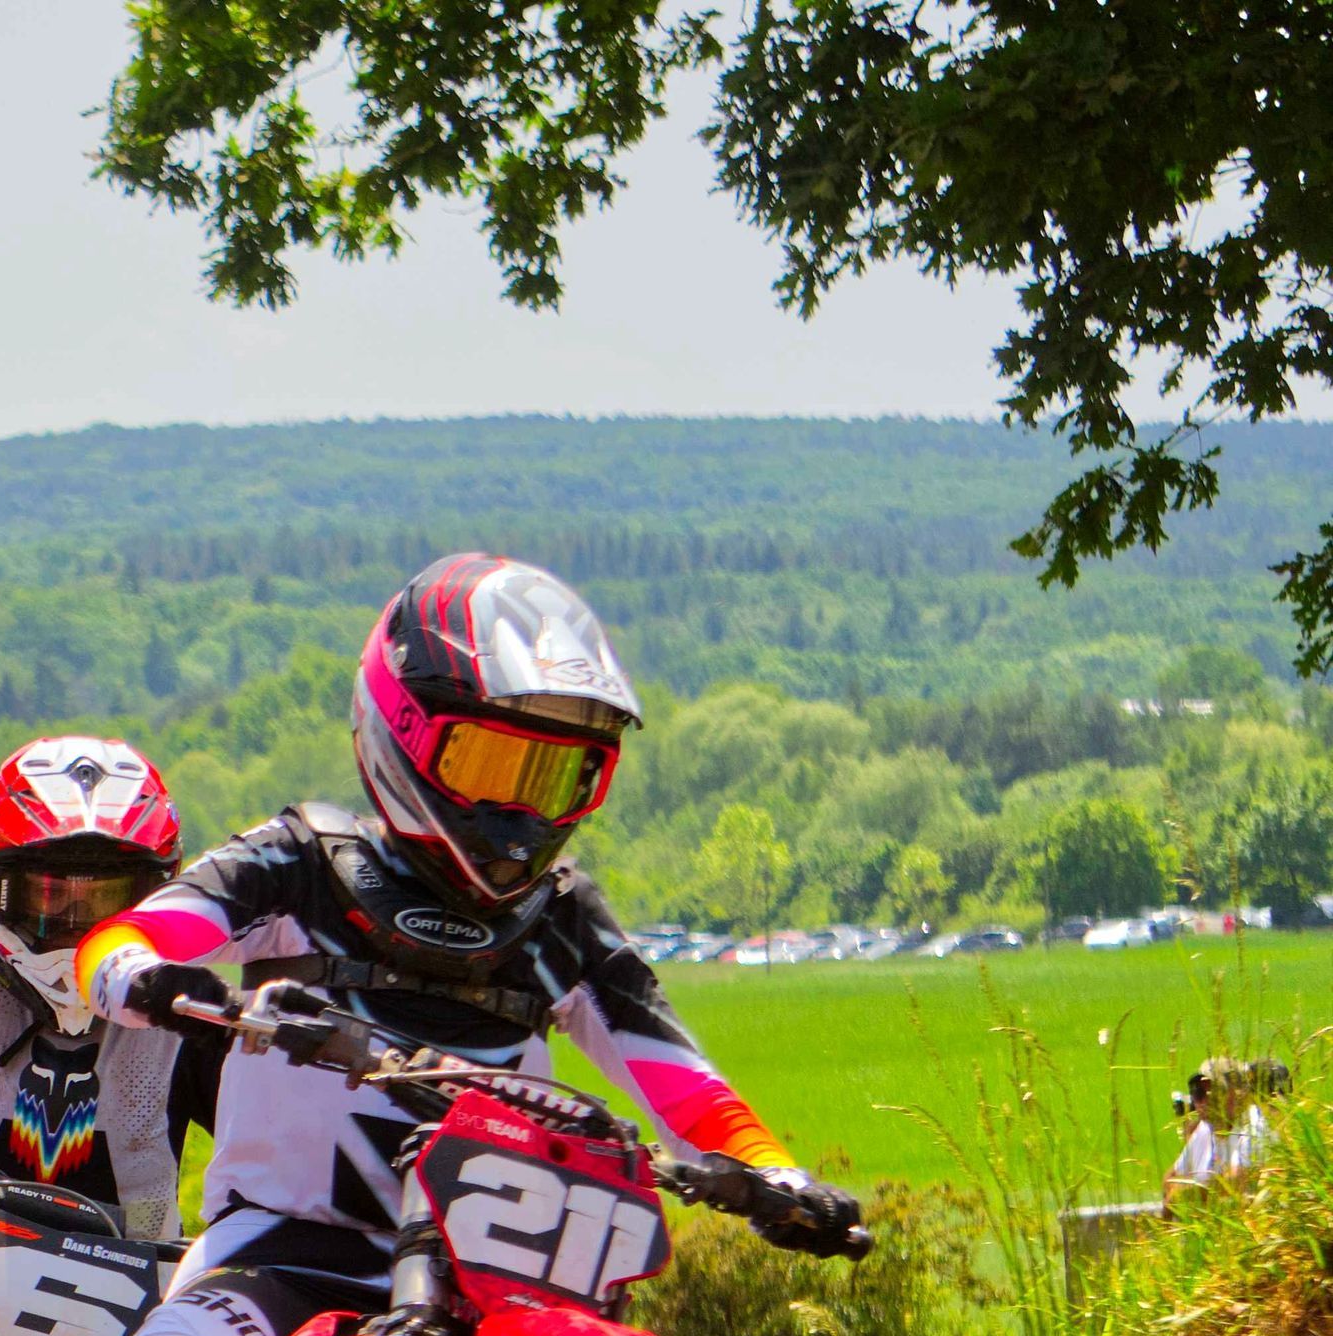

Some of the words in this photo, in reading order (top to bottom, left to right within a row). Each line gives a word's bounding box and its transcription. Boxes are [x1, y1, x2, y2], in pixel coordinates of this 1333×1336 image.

[0, 879, 9, 912] OAKLEY
[405, 917, 482, 940] ORTEMA
[7, 1185, 39, 1199] READY
[40, 1193, 53, 1202] TO
[443, 1152, 659, 1301] 211
